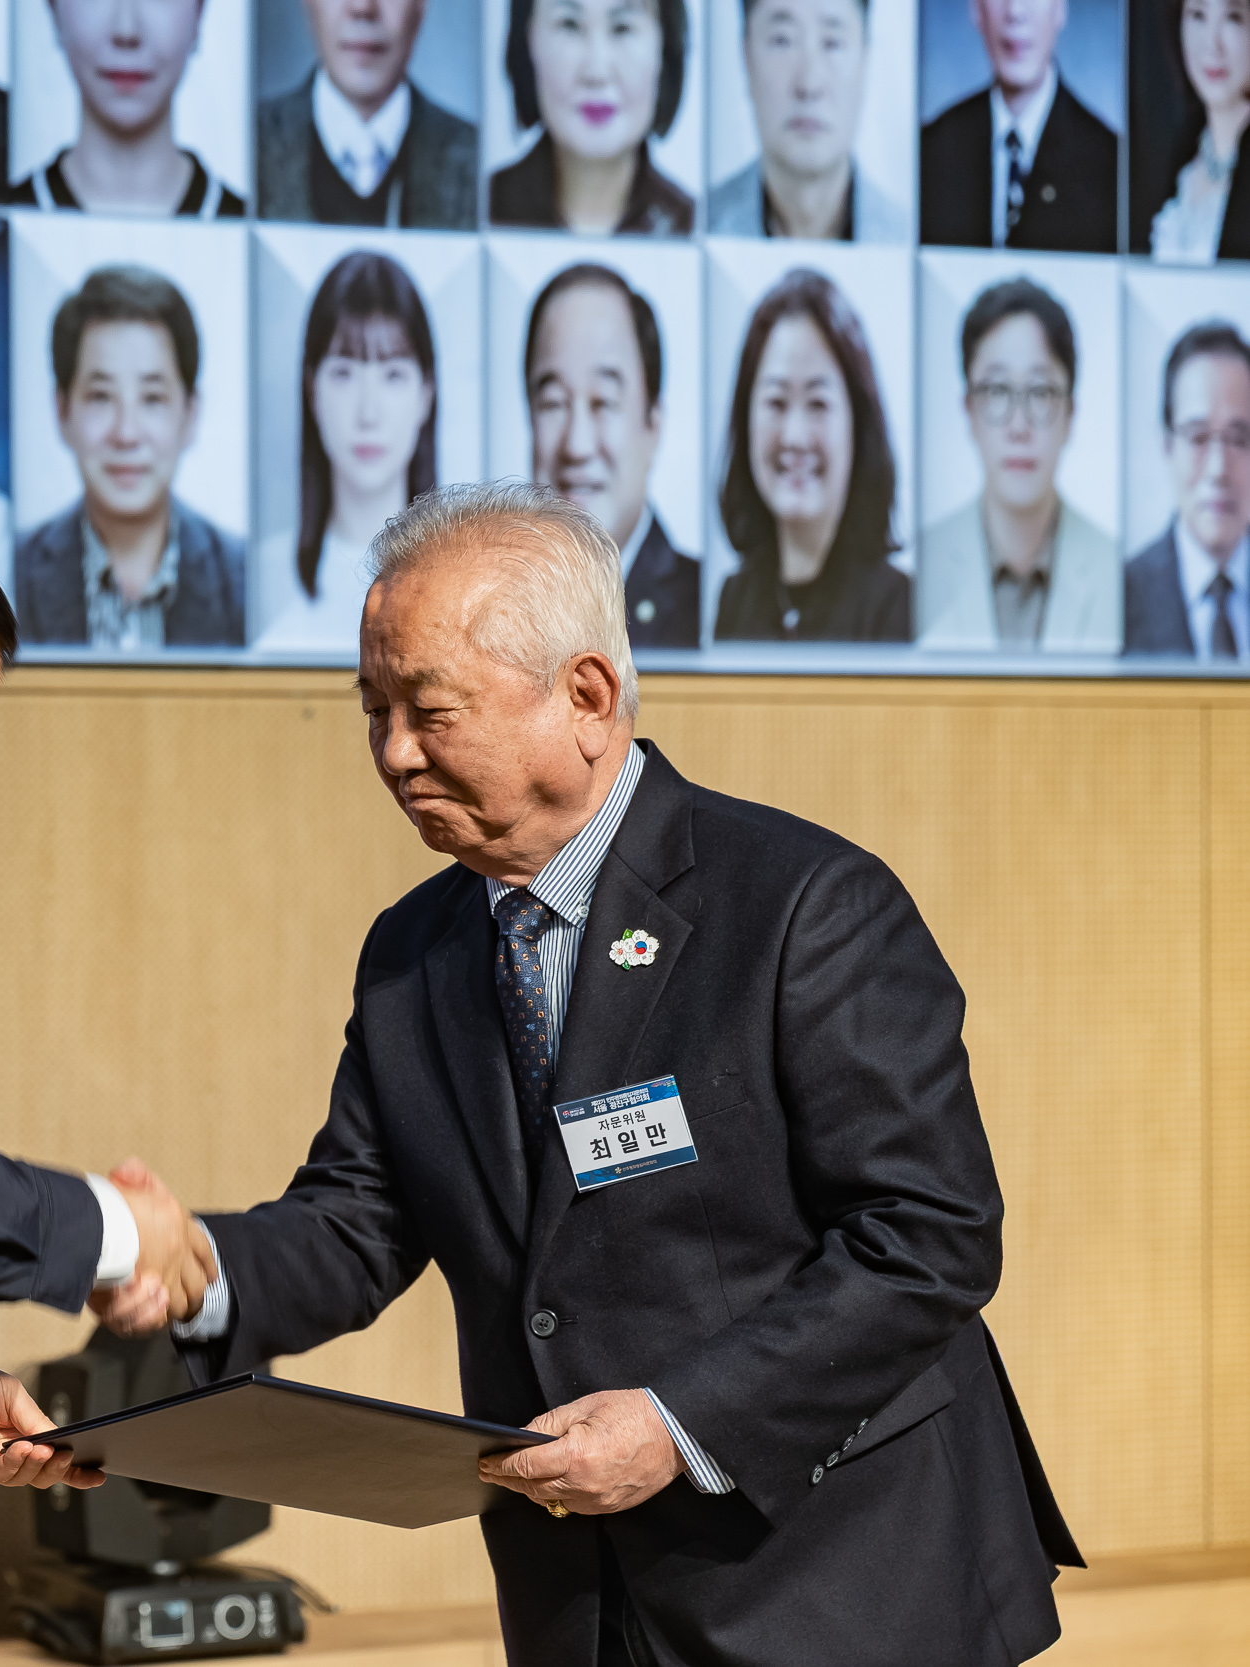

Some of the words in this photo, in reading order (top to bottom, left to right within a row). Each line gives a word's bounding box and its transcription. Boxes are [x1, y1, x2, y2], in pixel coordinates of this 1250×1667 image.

[593, 1103, 608, 1114] 서울
[609, 1092, 651, 1110] 광진구협의회
[598, 1109, 647, 1131] 자문위원
